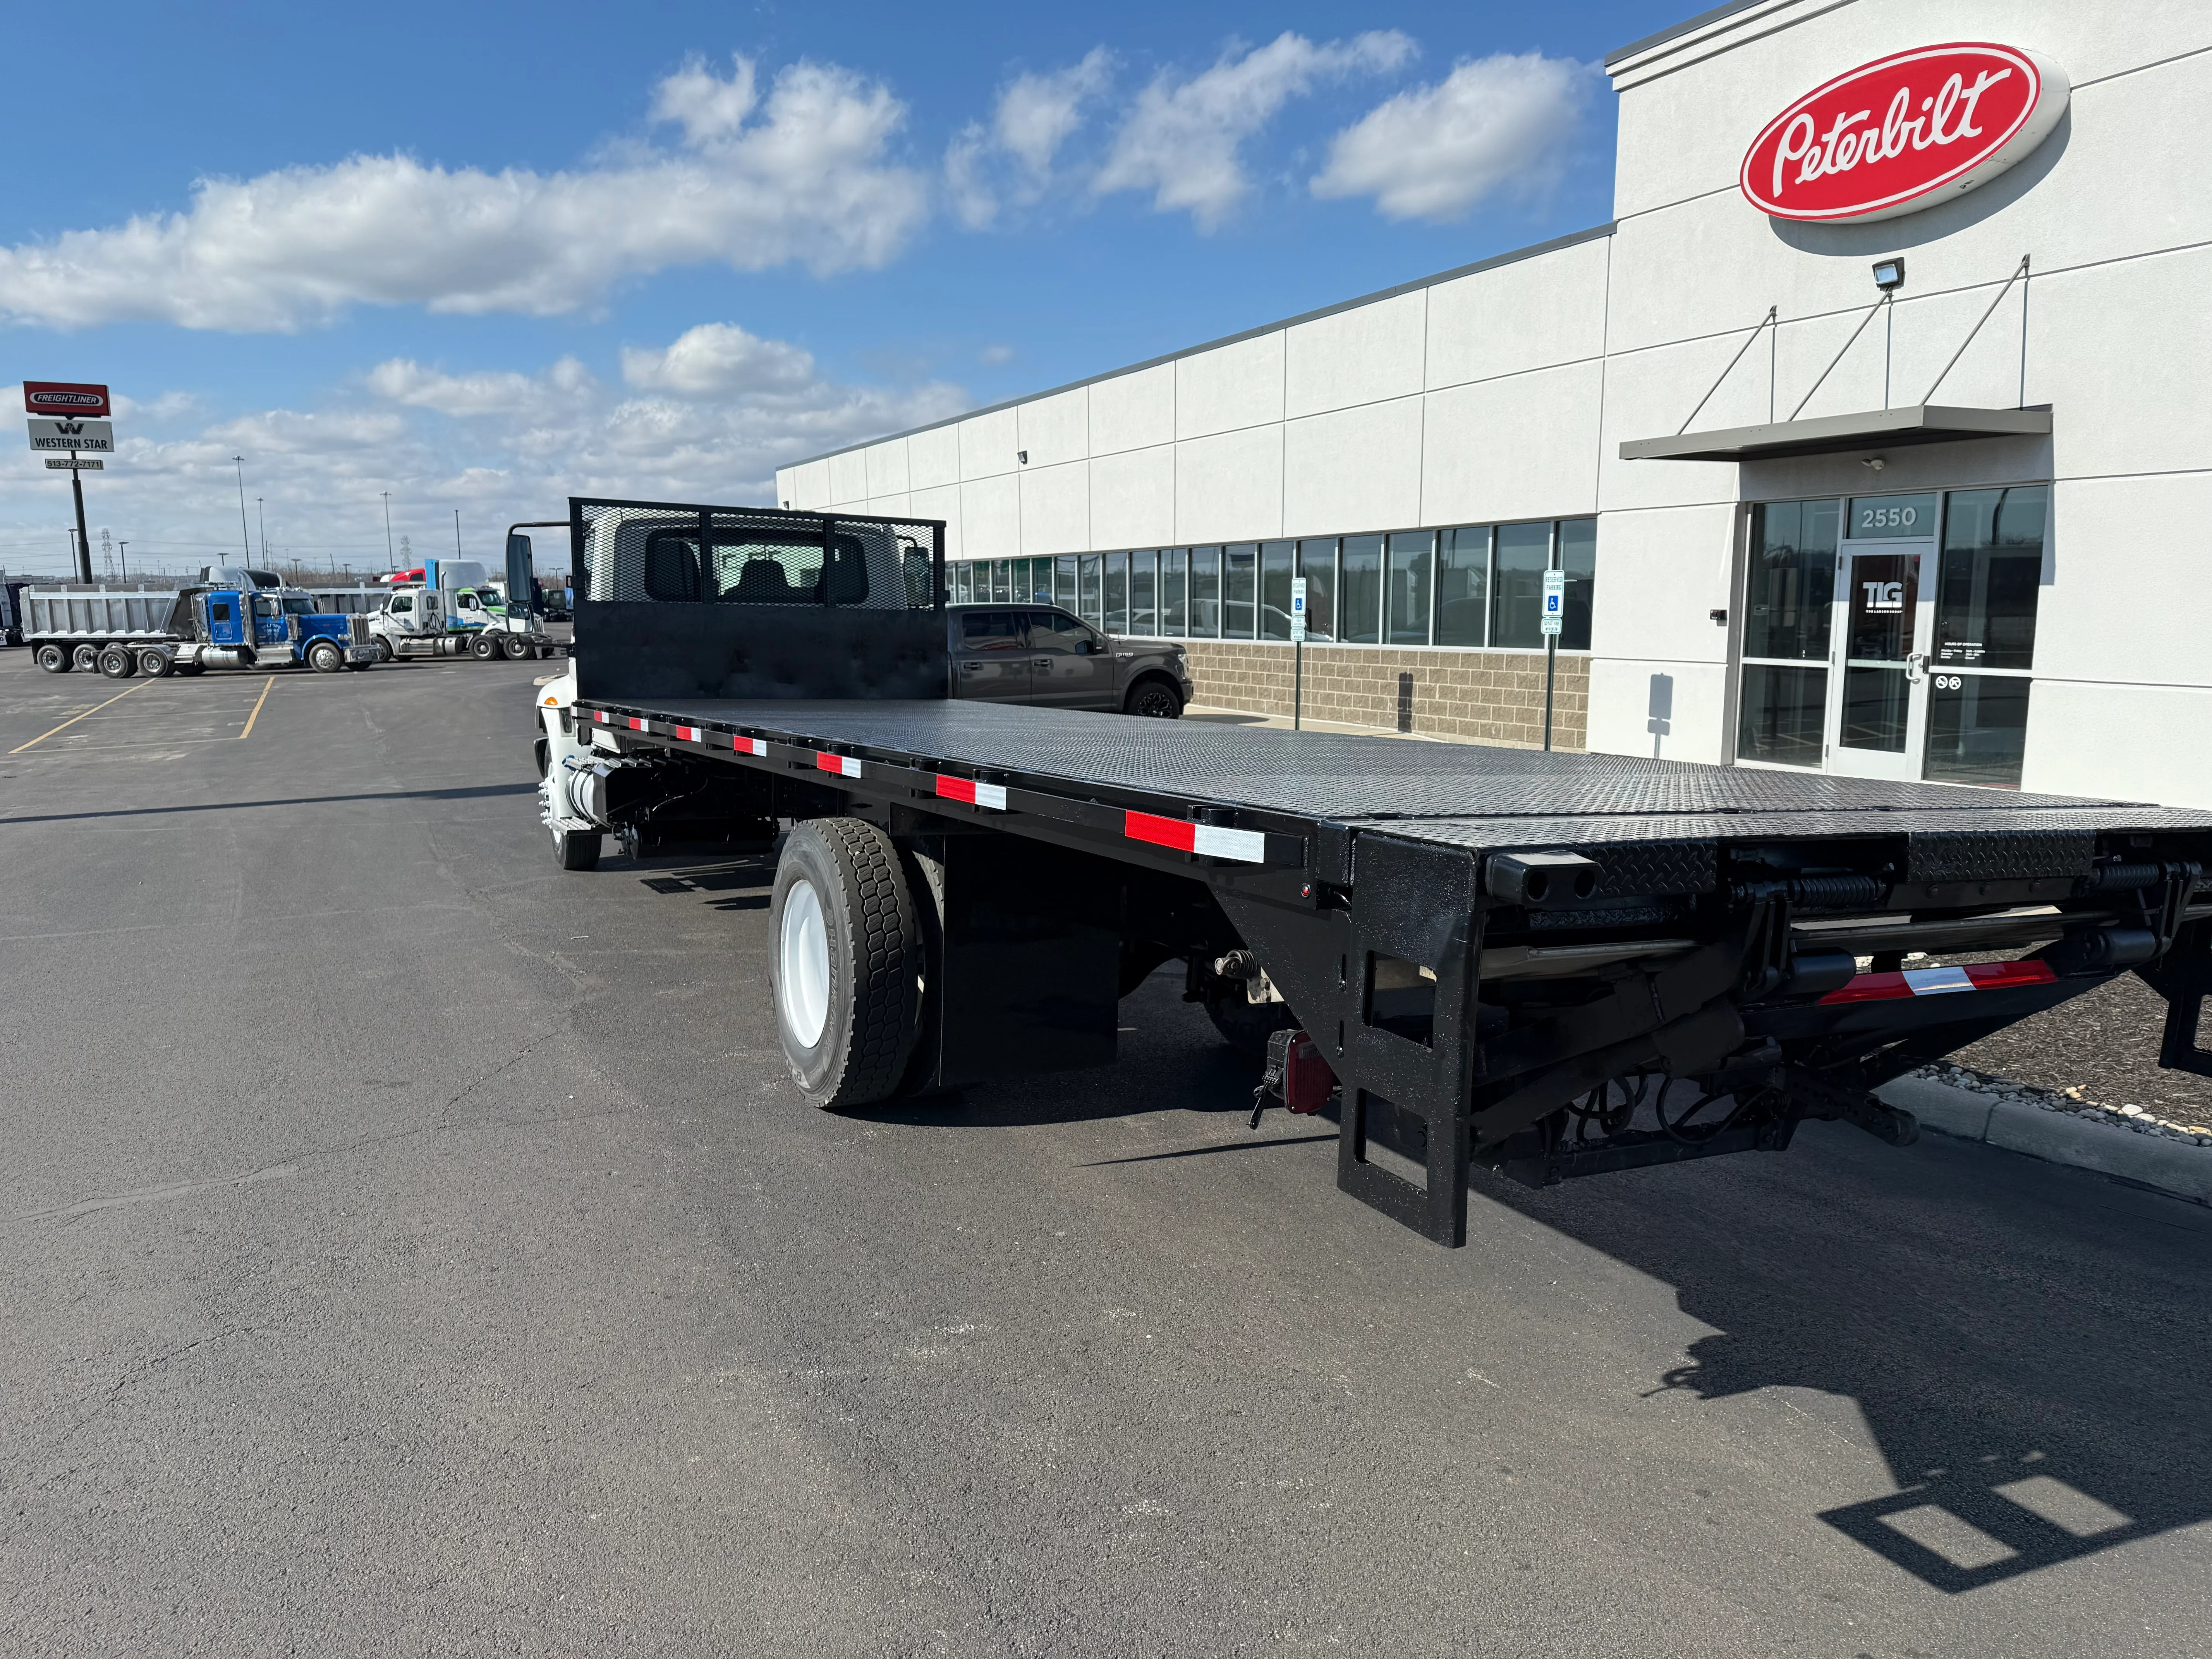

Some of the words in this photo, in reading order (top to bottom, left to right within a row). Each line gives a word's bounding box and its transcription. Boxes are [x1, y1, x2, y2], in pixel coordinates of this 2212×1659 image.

[1773, 67, 2012, 198] Peterbilt
[37, 394, 97, 404] FREIGHTLINER
[35, 438, 81, 448] WESTERN
[84, 439, 108, 449] STAR
[1862, 507, 1916, 528] 2550
[1863, 582, 1903, 608] TLG
